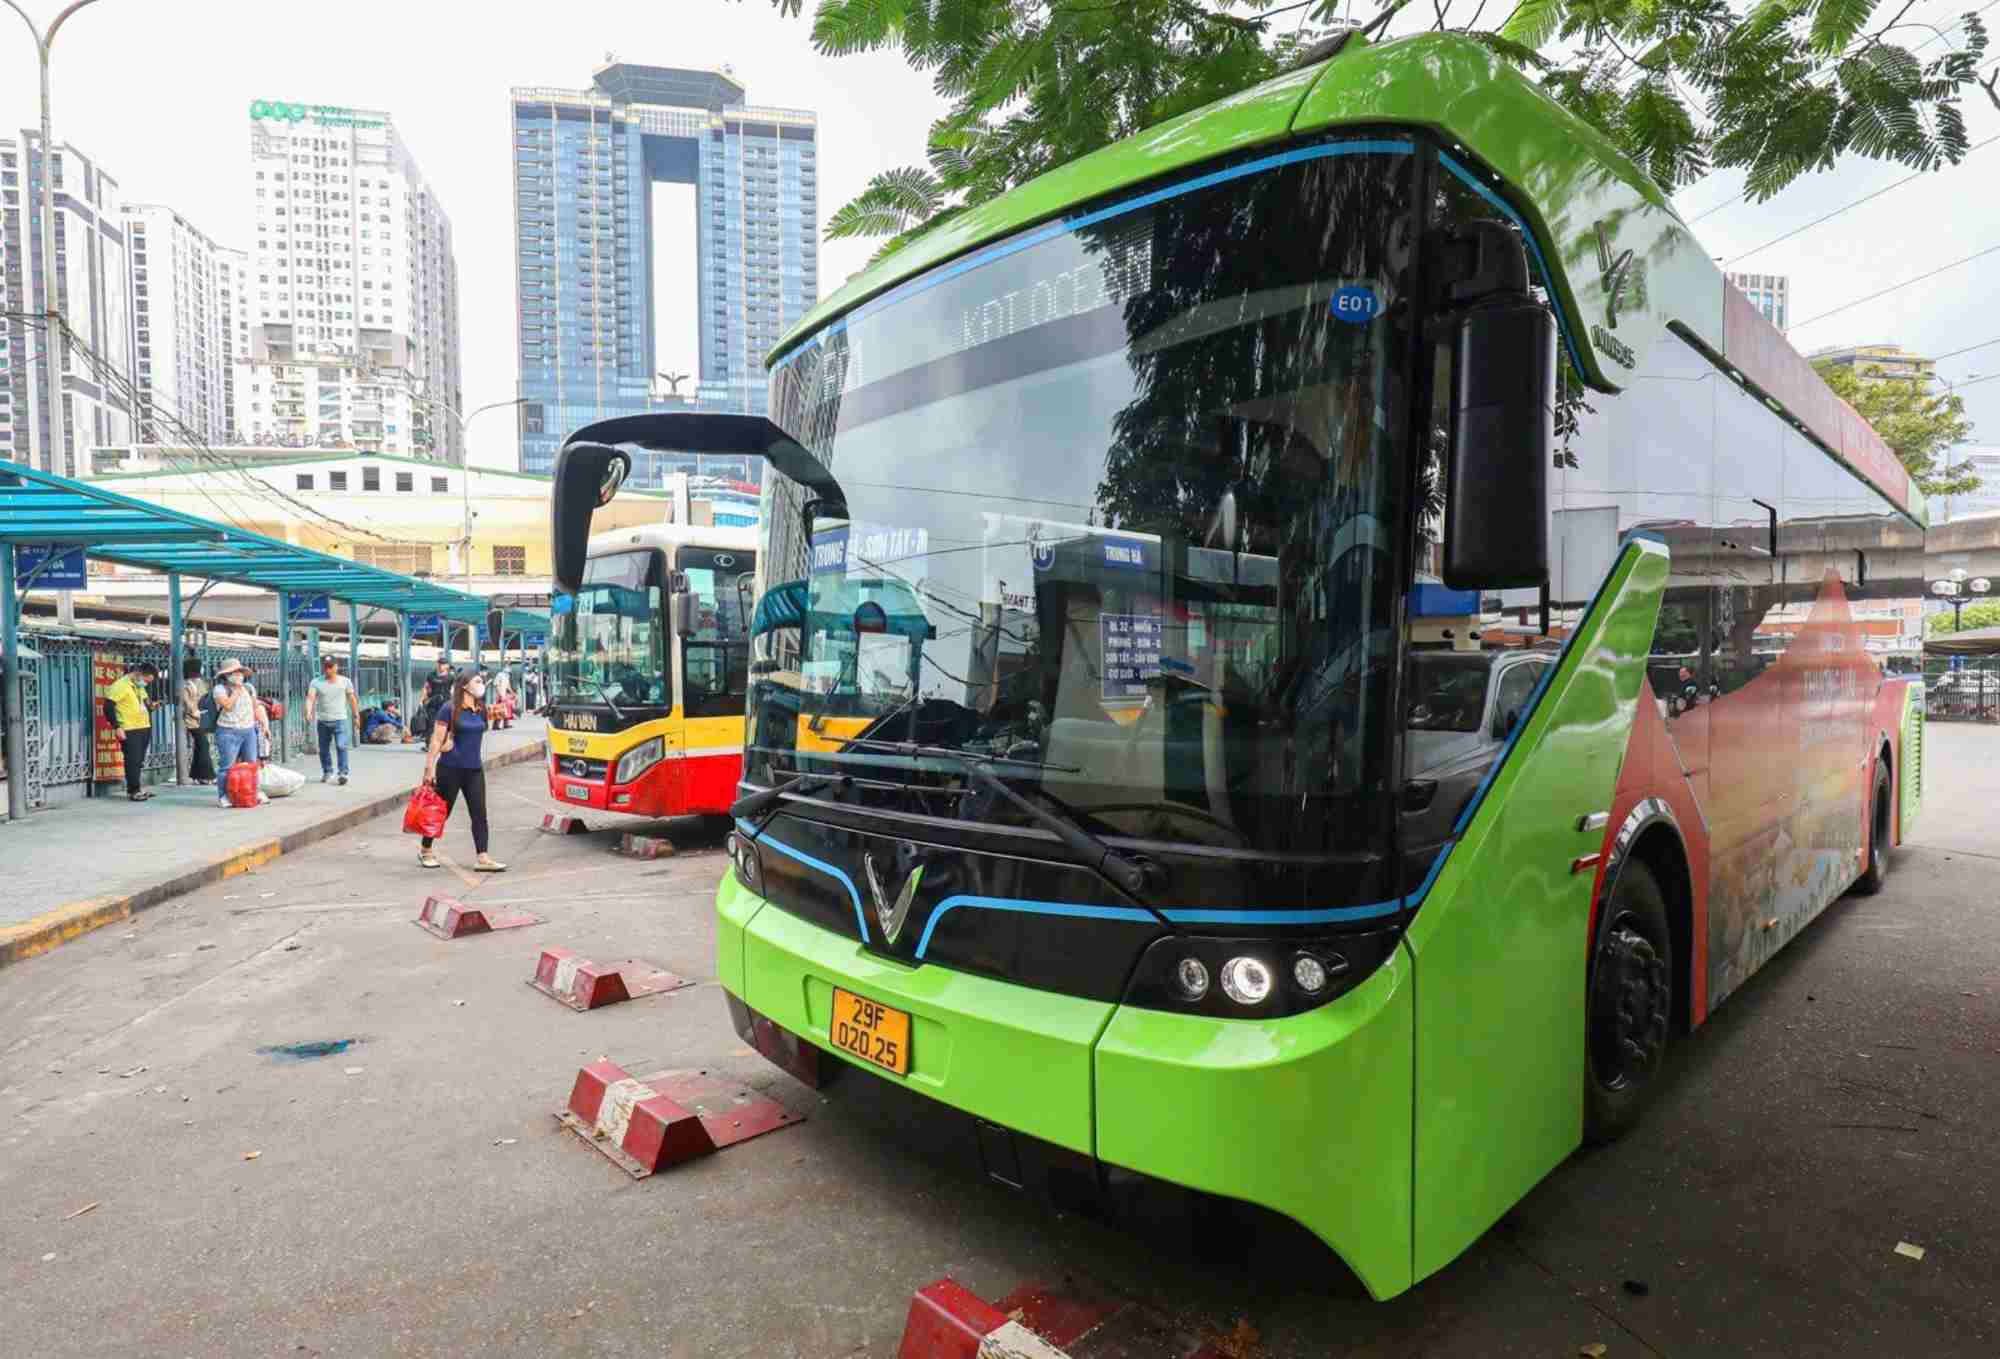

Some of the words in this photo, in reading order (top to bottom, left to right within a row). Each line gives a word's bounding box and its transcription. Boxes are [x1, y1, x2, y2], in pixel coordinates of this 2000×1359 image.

[1338, 295, 1372, 312] E01
[852, 998, 886, 1031] 29F
[838, 1021, 898, 1068] 020.25
